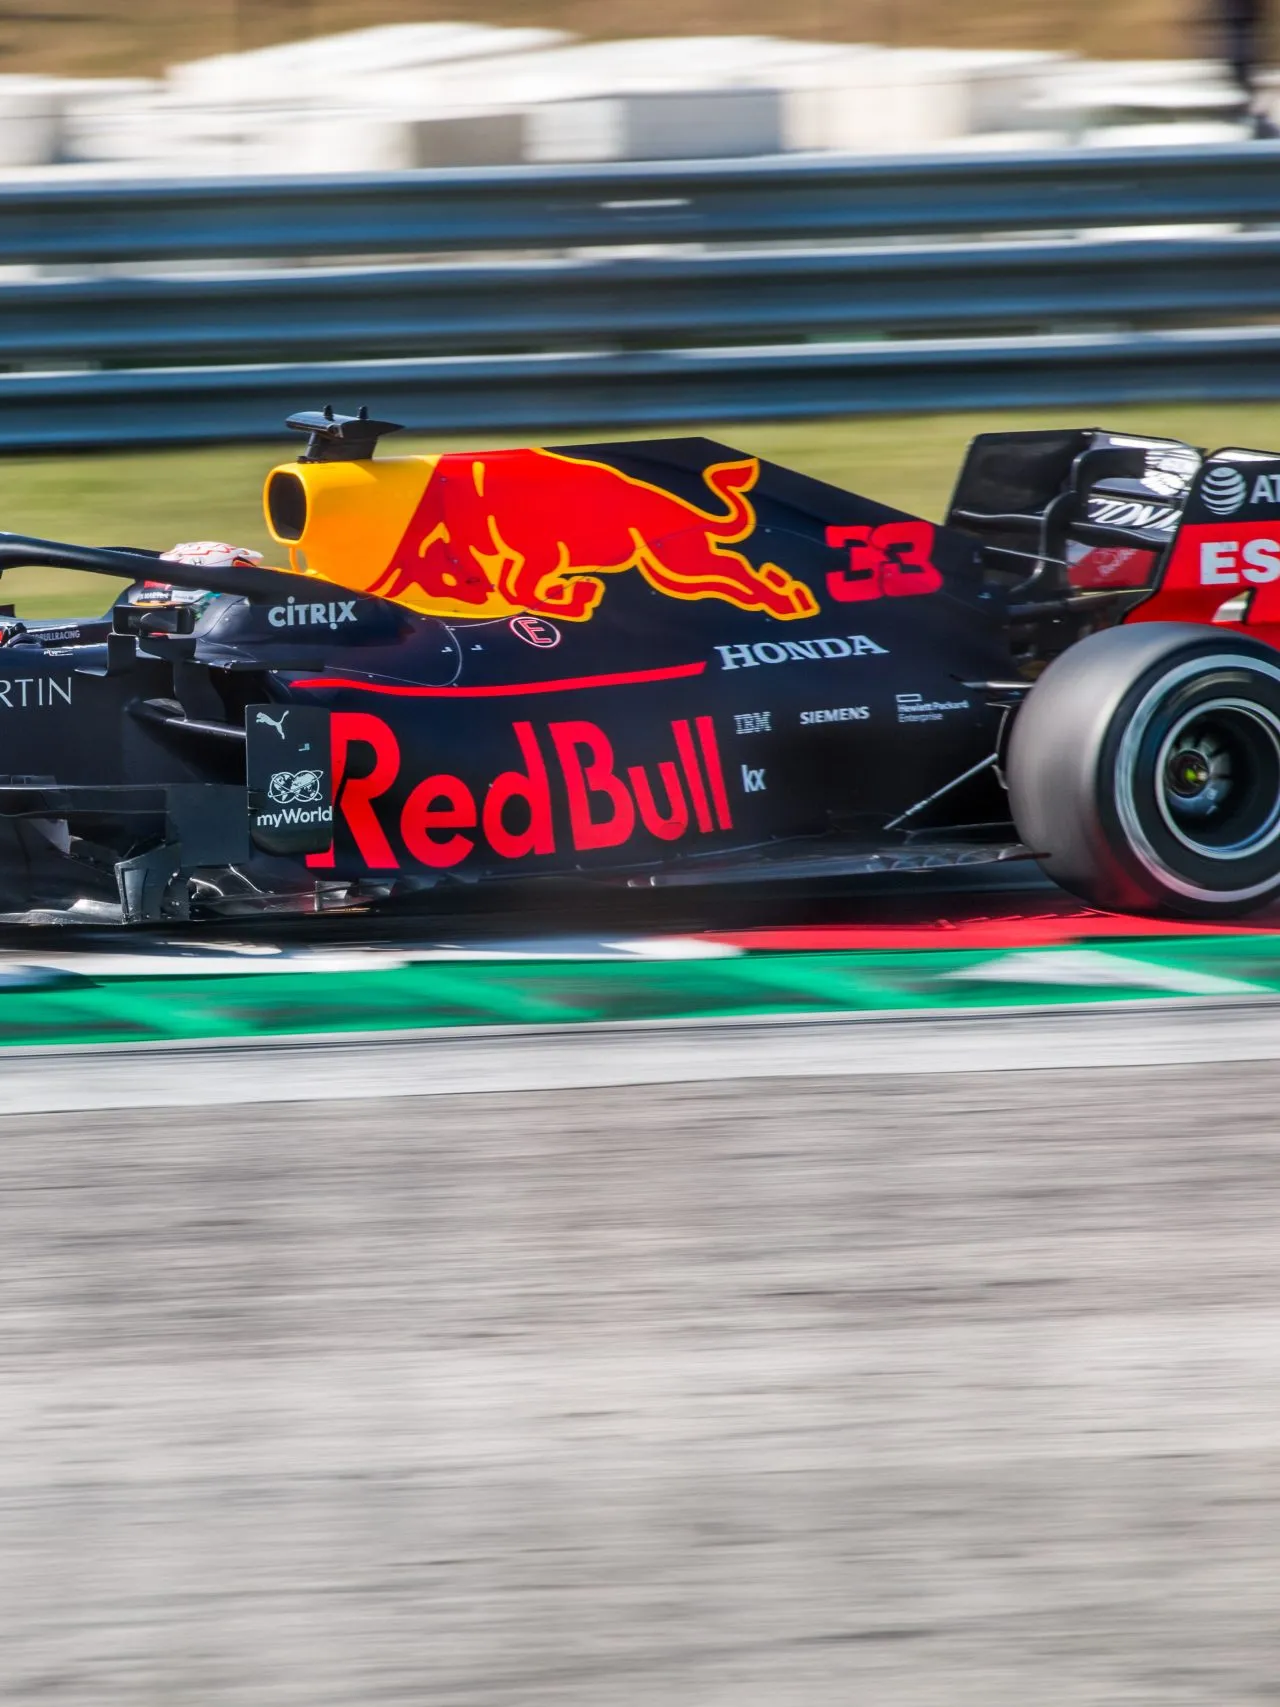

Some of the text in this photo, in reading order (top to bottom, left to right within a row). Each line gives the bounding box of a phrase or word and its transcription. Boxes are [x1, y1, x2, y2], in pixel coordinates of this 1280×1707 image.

[825, 521, 944, 602] 33
[713, 635, 890, 671] HONDA
[733, 711, 772, 734] IBM
[800, 706, 870, 725] SIEMENS
[256, 806, 333, 828] myWorld
